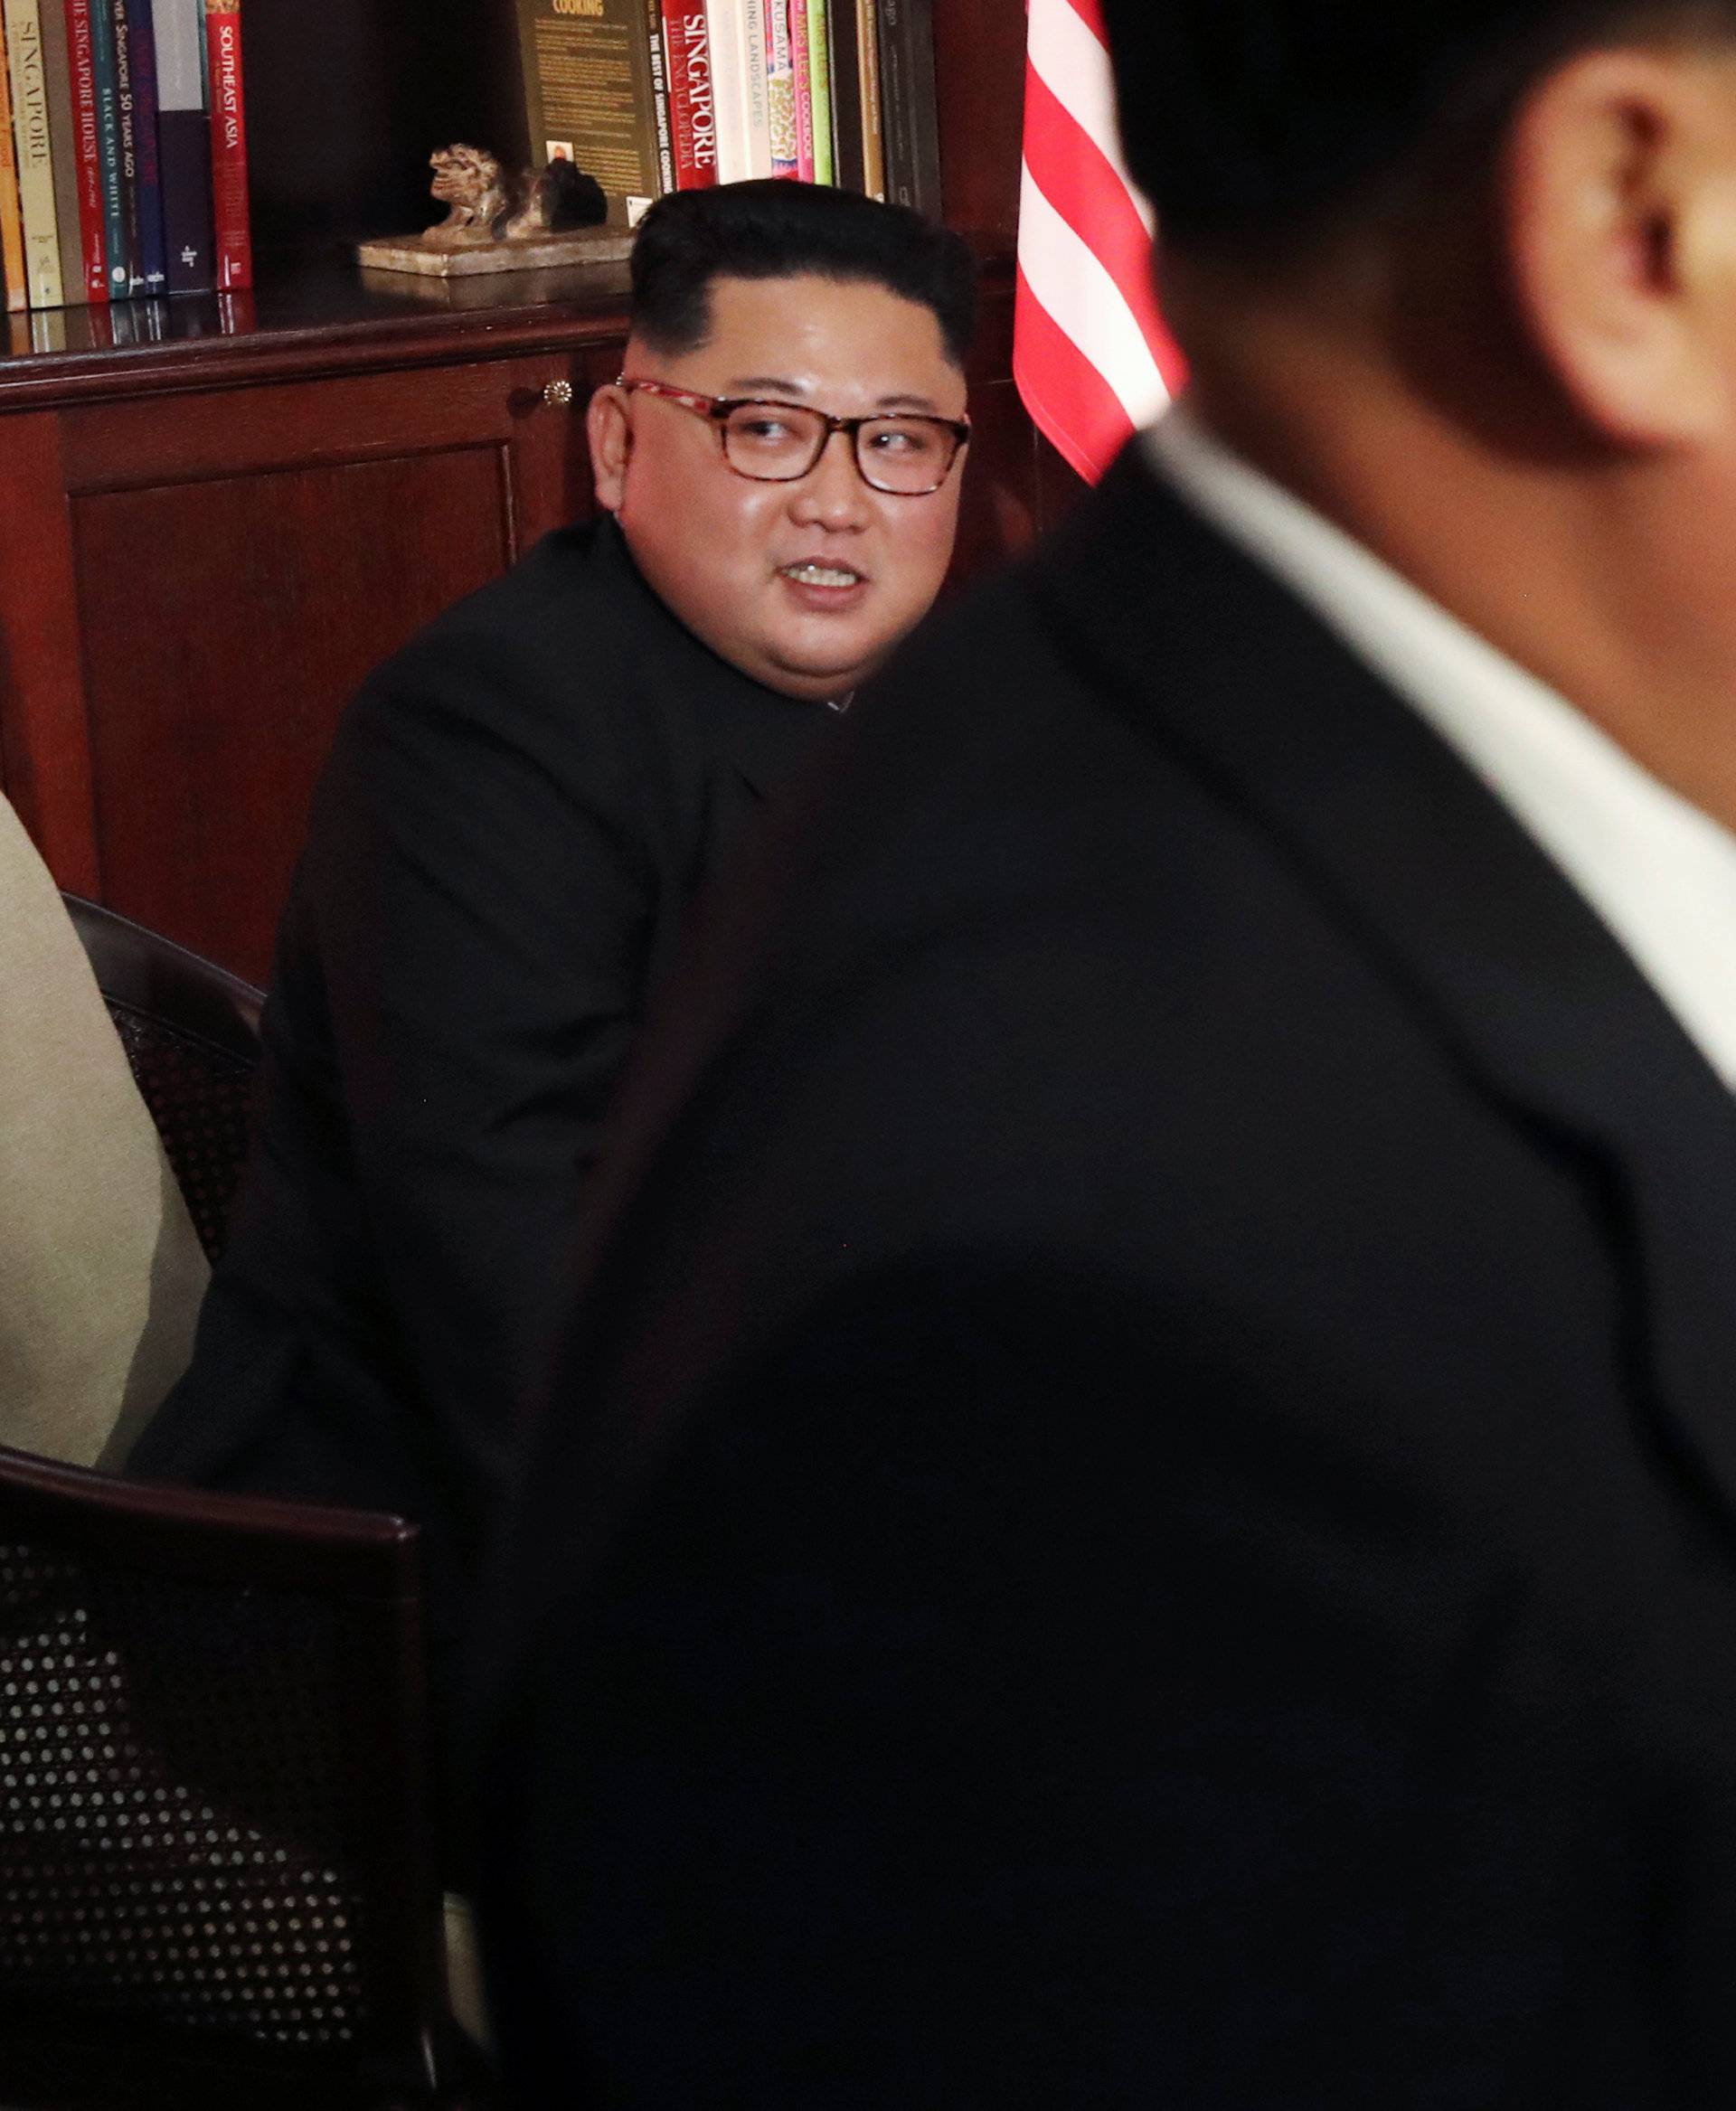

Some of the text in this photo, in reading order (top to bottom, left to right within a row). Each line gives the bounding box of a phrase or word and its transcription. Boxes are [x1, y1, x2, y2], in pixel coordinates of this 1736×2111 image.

[552, 0, 603, 16] COOKING
[116, 24, 129, 90] SINGAPORE
[650, 33, 661, 52] THE
[774, 0, 788, 72] KUSAMA
[74, 20, 93, 108] SINGAPORE
[219, 25, 236, 112] SOUTHEAST
[651, 54, 662, 76] BEST
[654, 78, 664, 90] OF
[750, 34, 764, 127] LANDSCAPES
[21, 22, 47, 168] SINGAPORE
[101, 88, 112, 131] BLACK
[120, 93, 132, 110] 50
[670, 19, 693, 169] THE ENCYCLOPEDIA
[684, 14, 715, 168] SINGAPORE
[81, 111, 97, 163] HOUSE
[122, 115, 133, 147] YEARS
[225, 116, 238, 148] ASIA
[656, 93, 669, 148] SINGAPORE
[801, 91, 811, 160] COOKBOOK
[106, 137, 116, 167] AND
[125, 152, 134, 177] AGO
[661, 149, 673, 193] COOKING
[109, 173, 119, 217] WHITE
